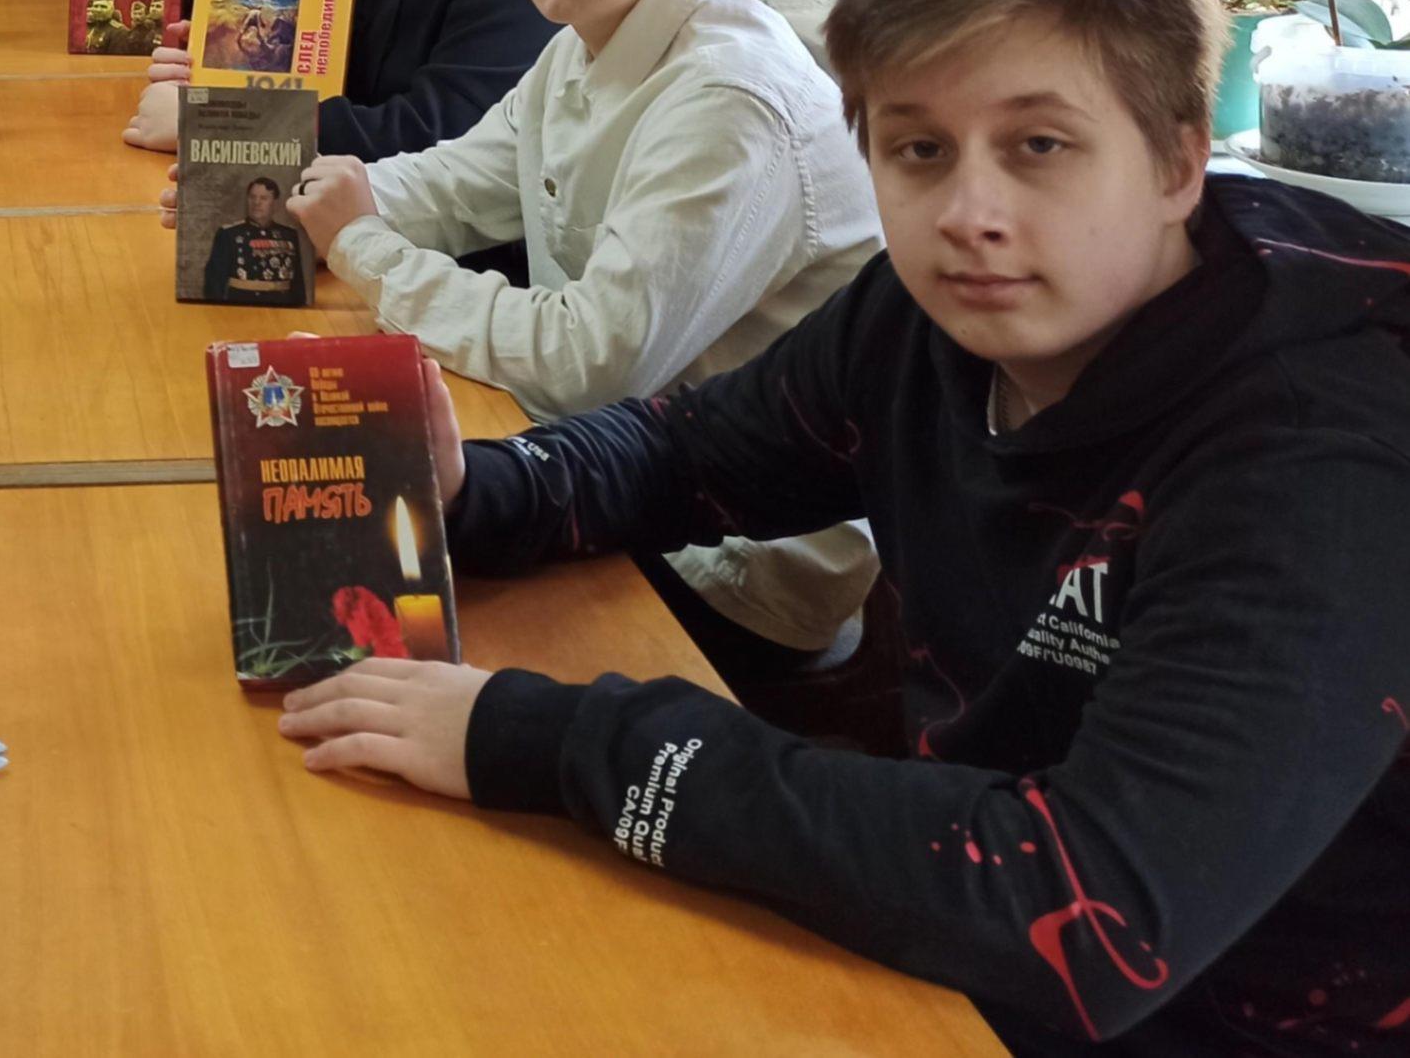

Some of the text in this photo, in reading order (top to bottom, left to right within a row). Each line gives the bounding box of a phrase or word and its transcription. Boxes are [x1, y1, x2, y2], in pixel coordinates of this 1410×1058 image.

[297, 31, 317, 74] СЛЕД
[190, 139, 302, 167] ВАСИЛЕВСКИЙ
[260, 455, 365, 483] НЕОПАЛИМАЯ
[262, 483, 372, 524] ПАМЯТЬ
[638, 742, 679, 816] Premium
[664, 738, 703, 795] Original
